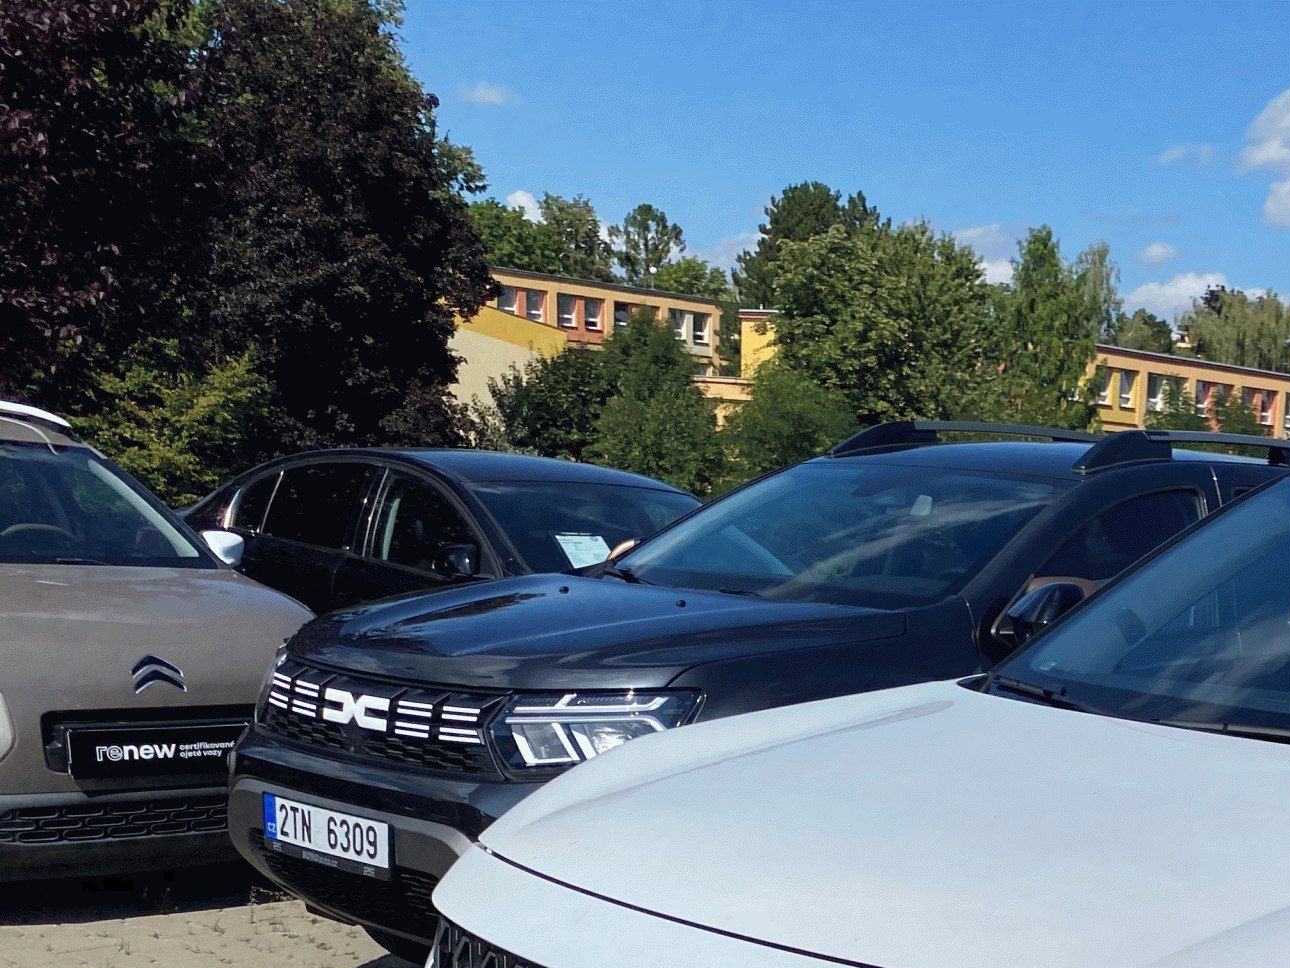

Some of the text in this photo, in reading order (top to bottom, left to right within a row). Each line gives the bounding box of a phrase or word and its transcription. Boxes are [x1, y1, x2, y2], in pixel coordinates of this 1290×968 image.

[96, 744, 176, 762] renew
[280, 804, 312, 843] 2TN
[327, 816, 377, 859] 6309
